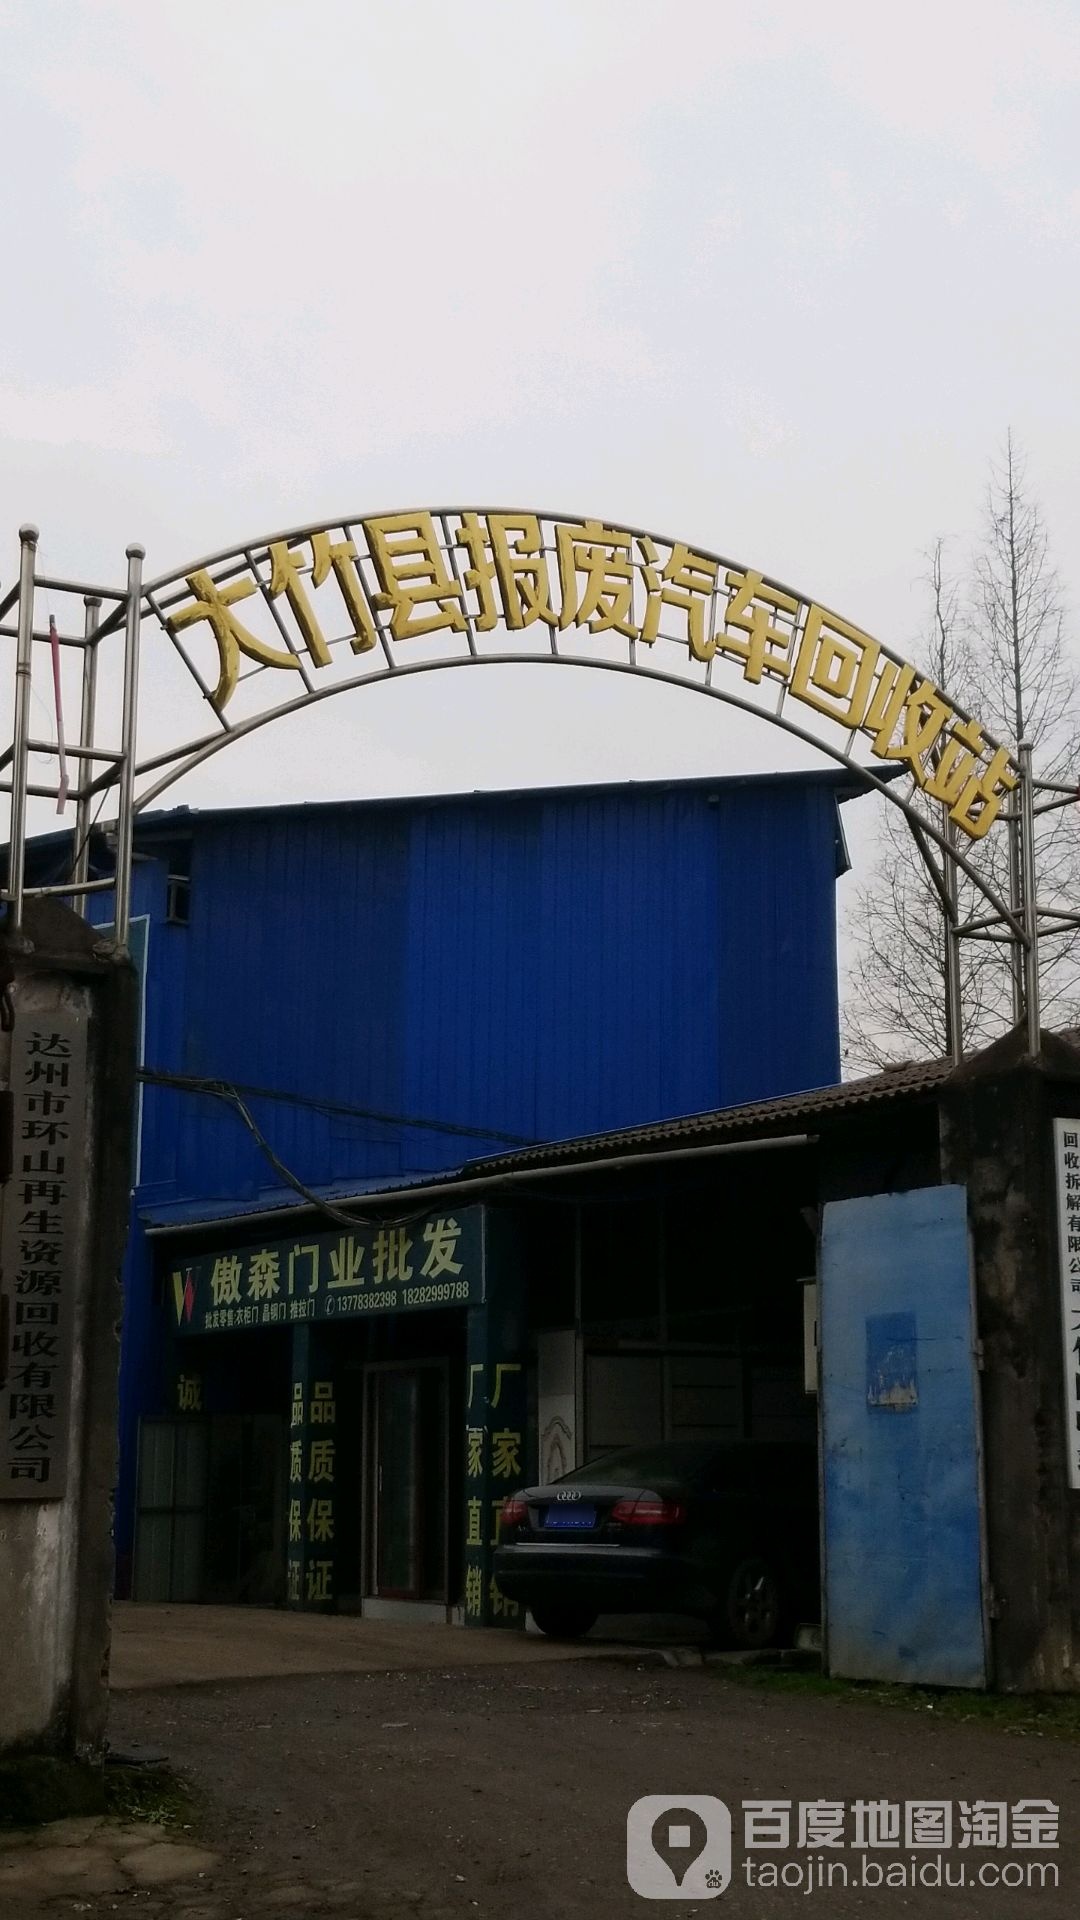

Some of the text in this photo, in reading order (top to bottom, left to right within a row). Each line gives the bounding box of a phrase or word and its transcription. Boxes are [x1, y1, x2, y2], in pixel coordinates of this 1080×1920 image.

[167, 511, 1020, 840] 大竹县报废汽车回收站
[8, 1031, 71, 1483] 达州市环山再生资源回收有限公司
[210, 1217, 464, 1306] 傲森门业批发
[337, 1281, 470, 1312] 13778382398 18282999788
[306, 1380, 336, 1601] 品质保证
[465, 1363, 488, 1617] 厂家直销
